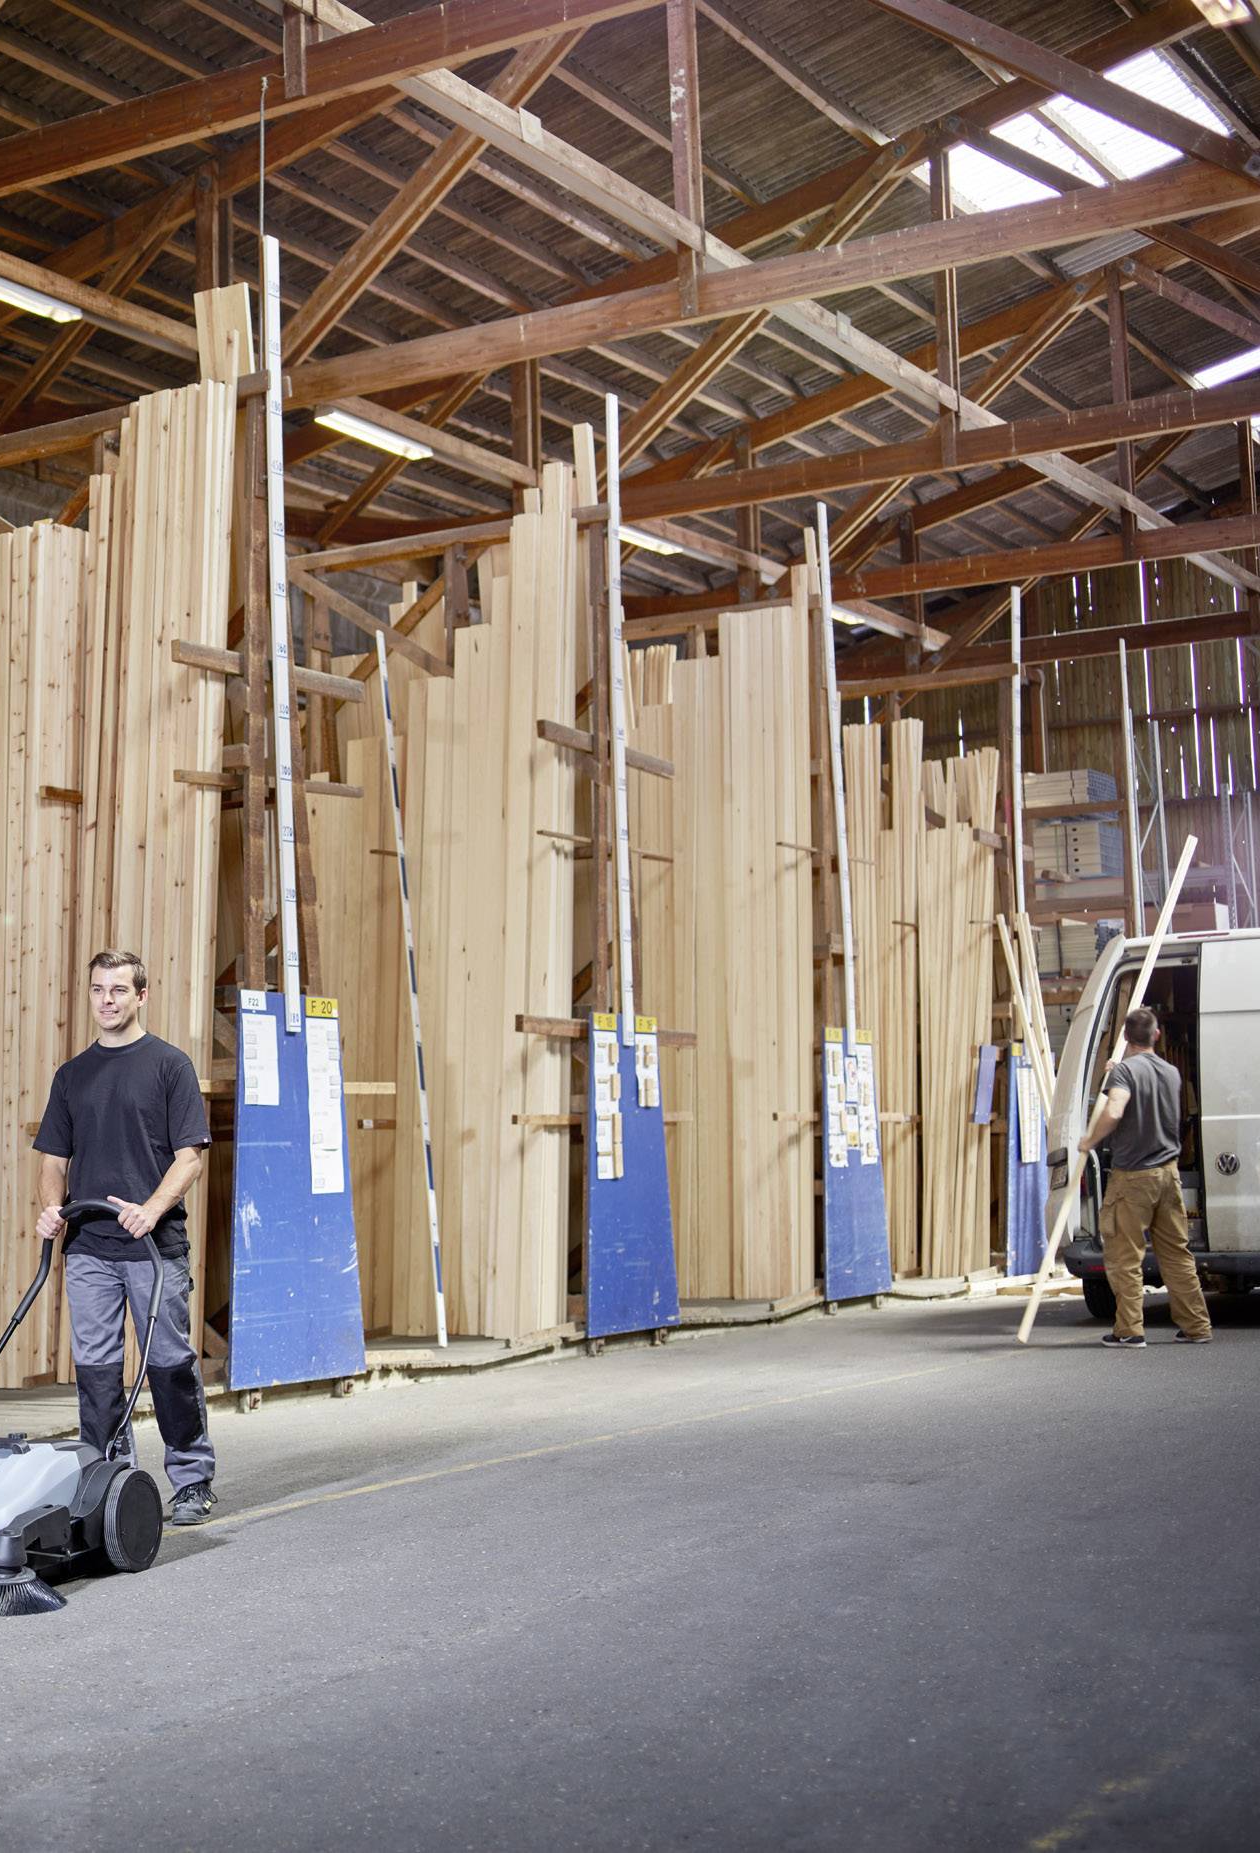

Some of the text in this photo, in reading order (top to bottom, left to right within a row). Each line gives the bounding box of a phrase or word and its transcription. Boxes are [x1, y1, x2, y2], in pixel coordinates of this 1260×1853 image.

[248, 997, 259, 1007] F22
[311, 1001, 333, 1015] F 20
